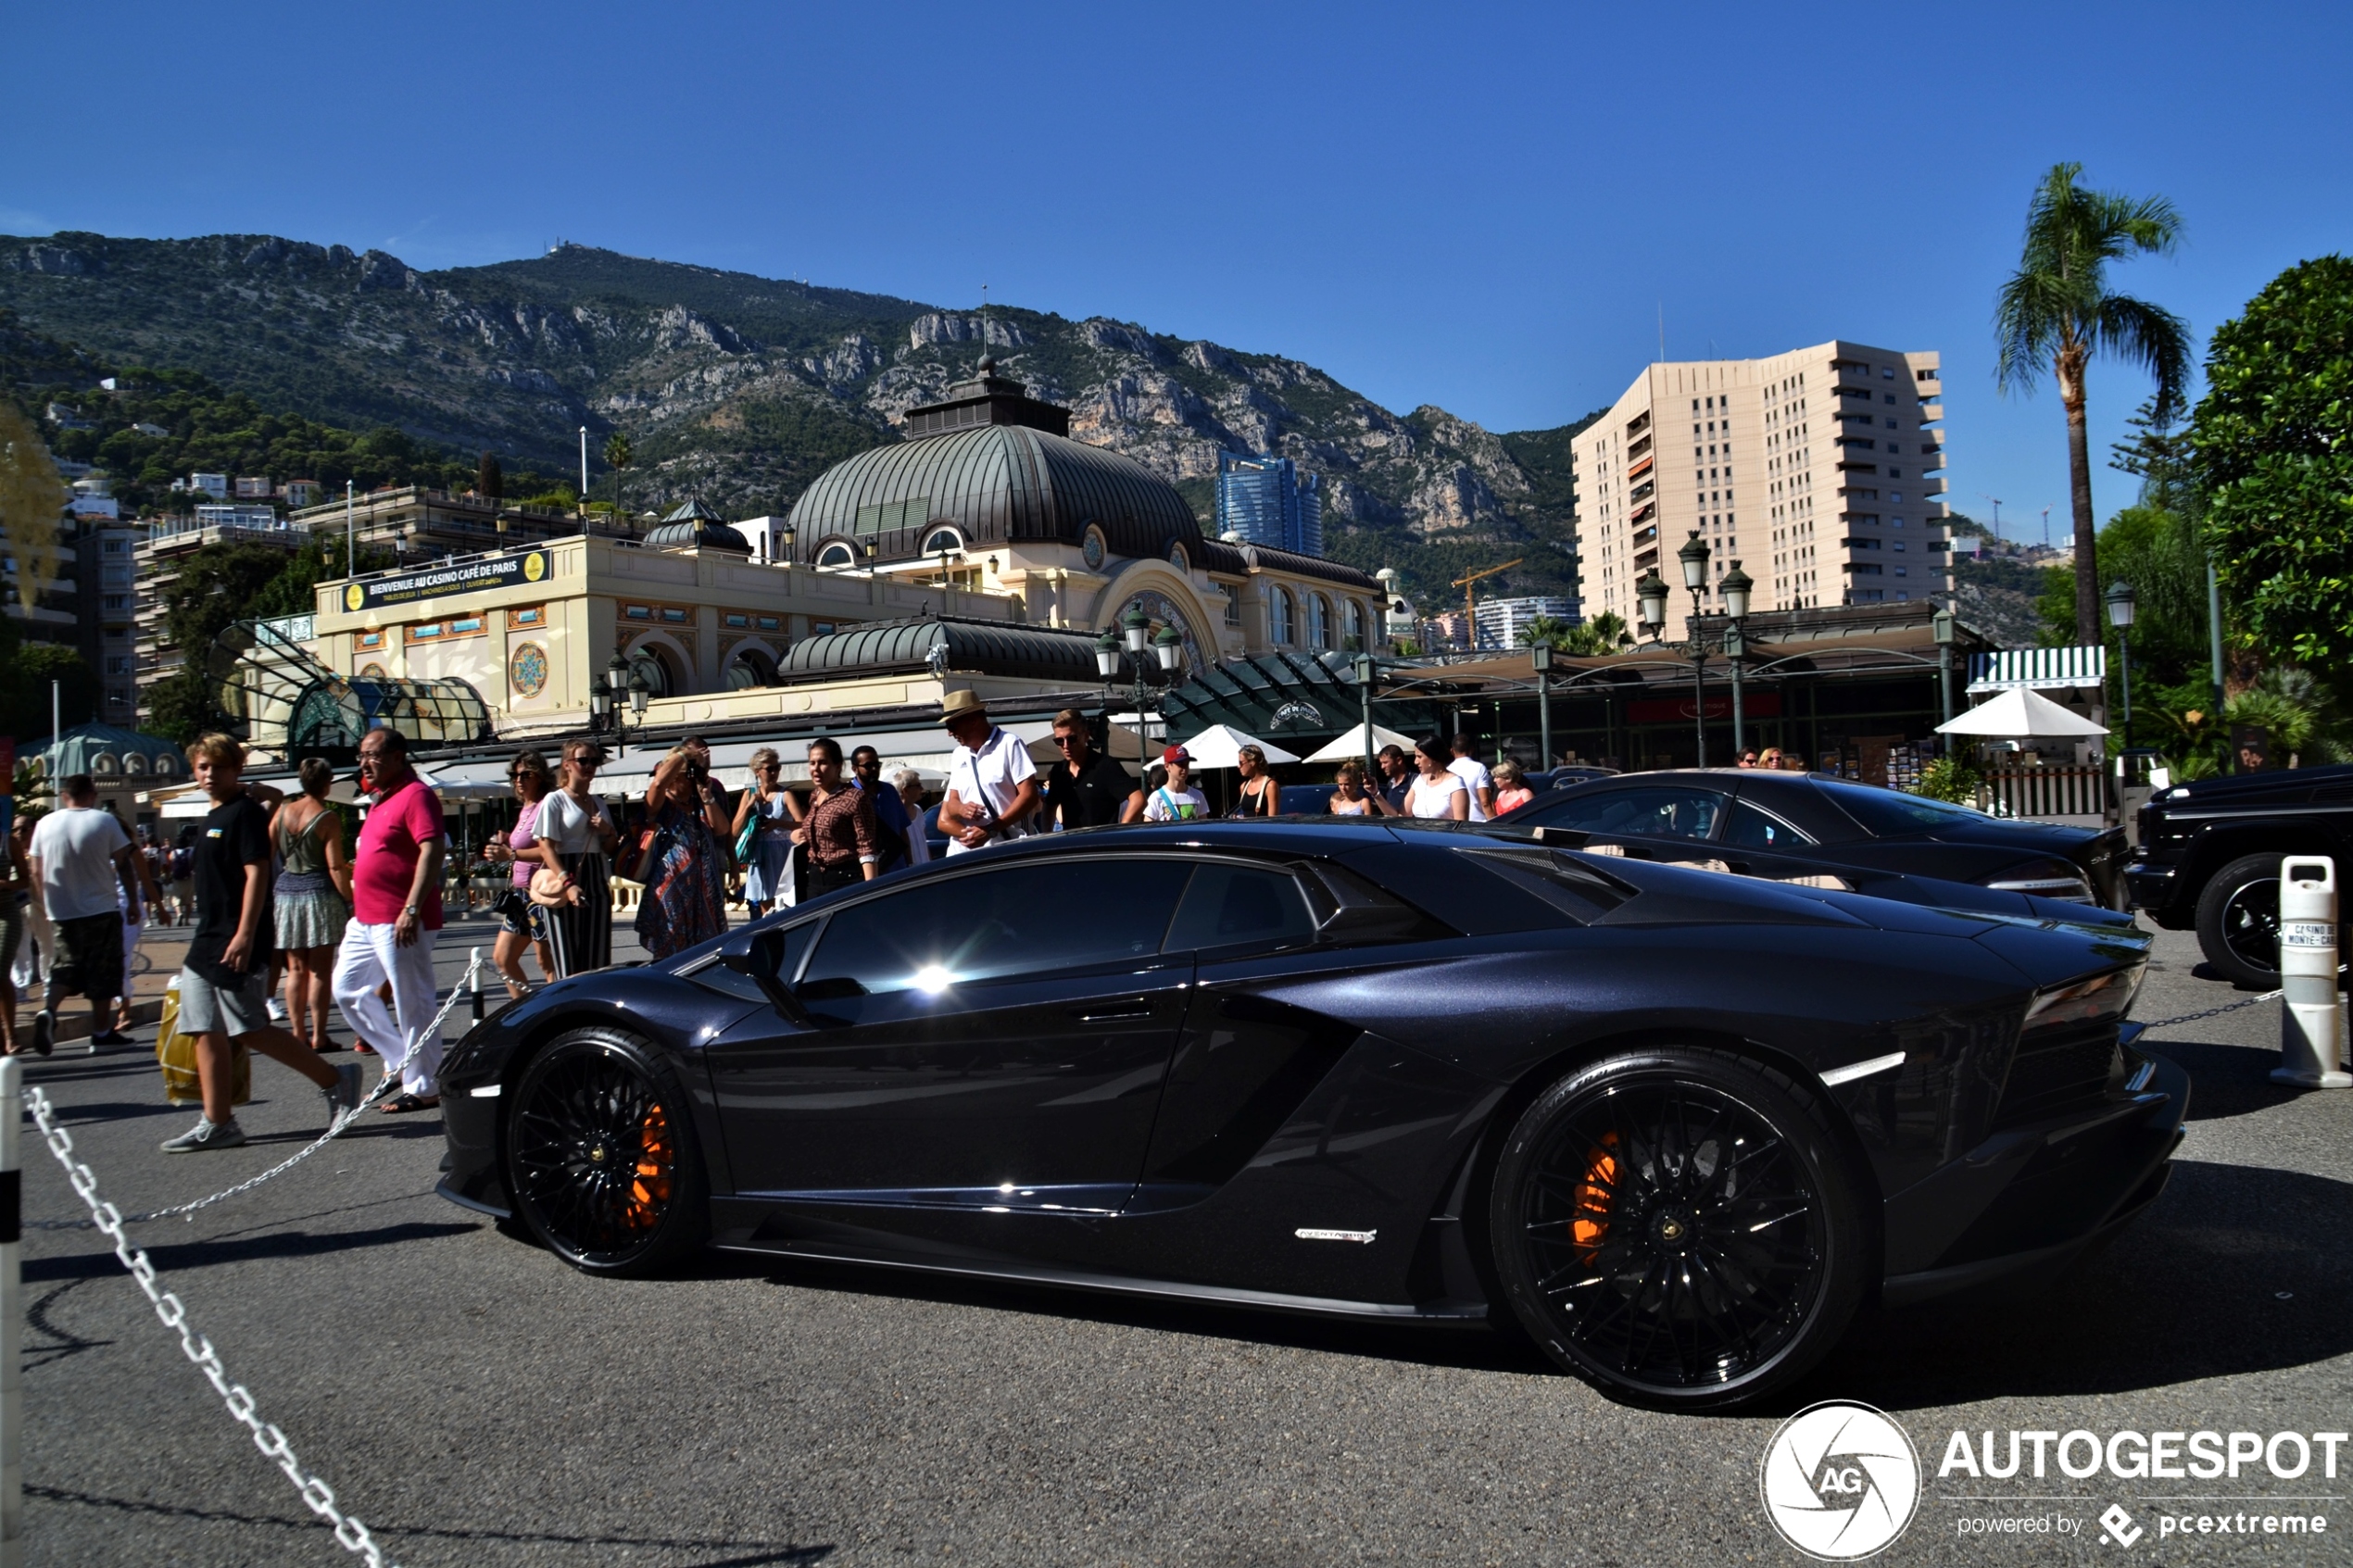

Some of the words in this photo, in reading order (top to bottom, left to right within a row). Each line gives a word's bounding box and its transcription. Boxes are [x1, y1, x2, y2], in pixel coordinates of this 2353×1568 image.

[370, 579, 413, 596] BIENVENUE
[415, 576, 426, 588] AU
[427, 571, 458, 586] CASINO
[459, 564, 479, 581] CAFÉ
[480, 565, 492, 577] DE
[492, 560, 517, 574] PARIS
[383, 593, 399, 602] TABLES
[422, 585, 446, 596] MACHINES
[448, 583, 461, 591] SOUS
[466, 579, 485, 589] OUVERT
[1300, 707, 1317, 717] PARIS
